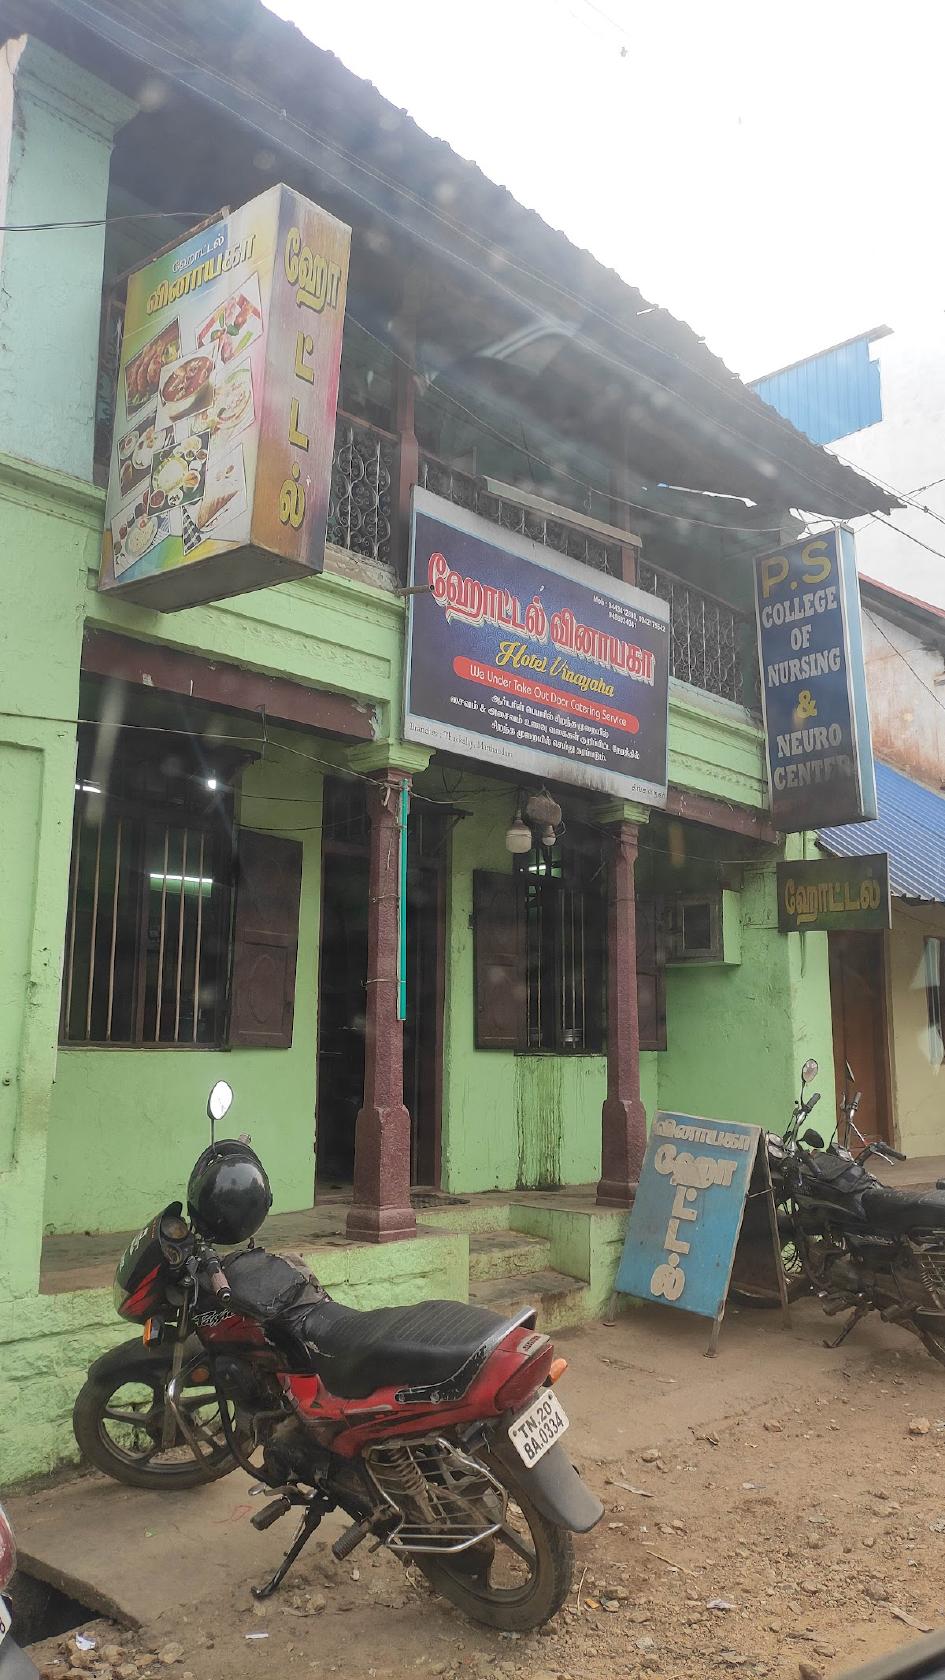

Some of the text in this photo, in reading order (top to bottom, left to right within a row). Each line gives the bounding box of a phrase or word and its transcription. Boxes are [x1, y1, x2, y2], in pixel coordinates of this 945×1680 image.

[172, 232, 225, 273] ஹோட்டல்
[761, 540, 832, 598] P.S
[428, 552, 548, 642] ஹோட்டல்
[761, 585, 838, 629] COLLEGE
[495, 641, 547, 672] Hotel
[790, 624, 812, 651] OF
[767, 647, 841, 688] NURSING
[470, 664, 627, 727] We Under Take Out Door Catering Service
[795, 690, 817, 719] &
[776, 723, 842, 758] NEURO
[518, 1401, 552, 1438] TN.20
[523, 1411, 564, 1461] BA.0334
